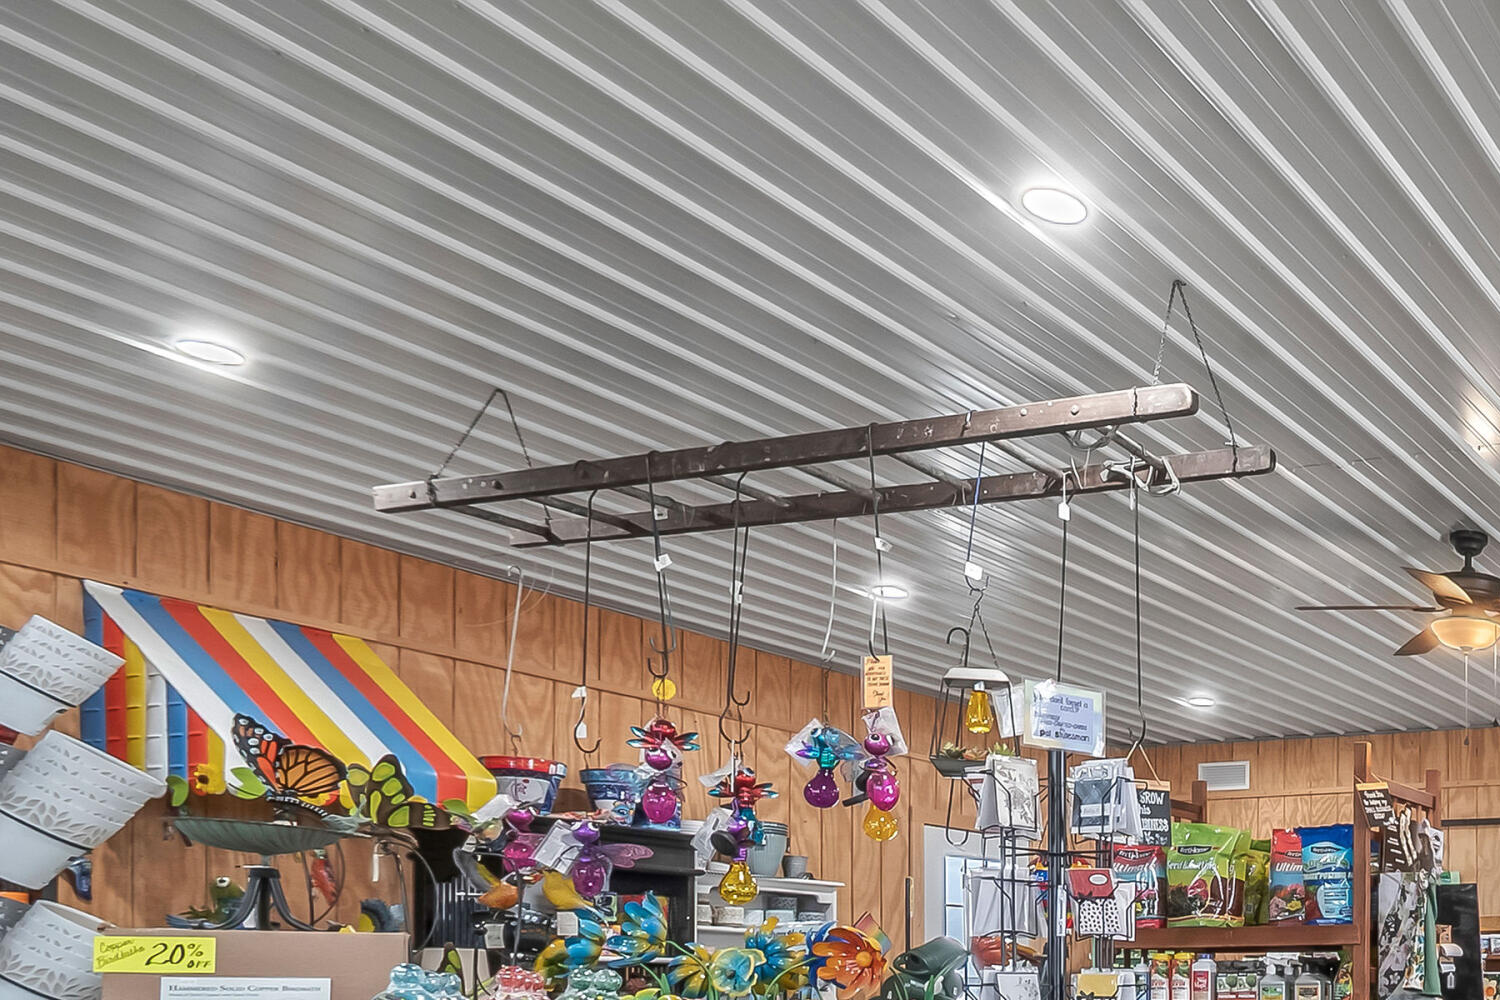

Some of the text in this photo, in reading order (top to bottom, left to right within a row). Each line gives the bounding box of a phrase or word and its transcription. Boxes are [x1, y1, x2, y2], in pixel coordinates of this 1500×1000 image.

[1275, 861, 1303, 872] Ultim
[145, 942, 204, 966] 20%
[187, 959, 211, 969] OFF
